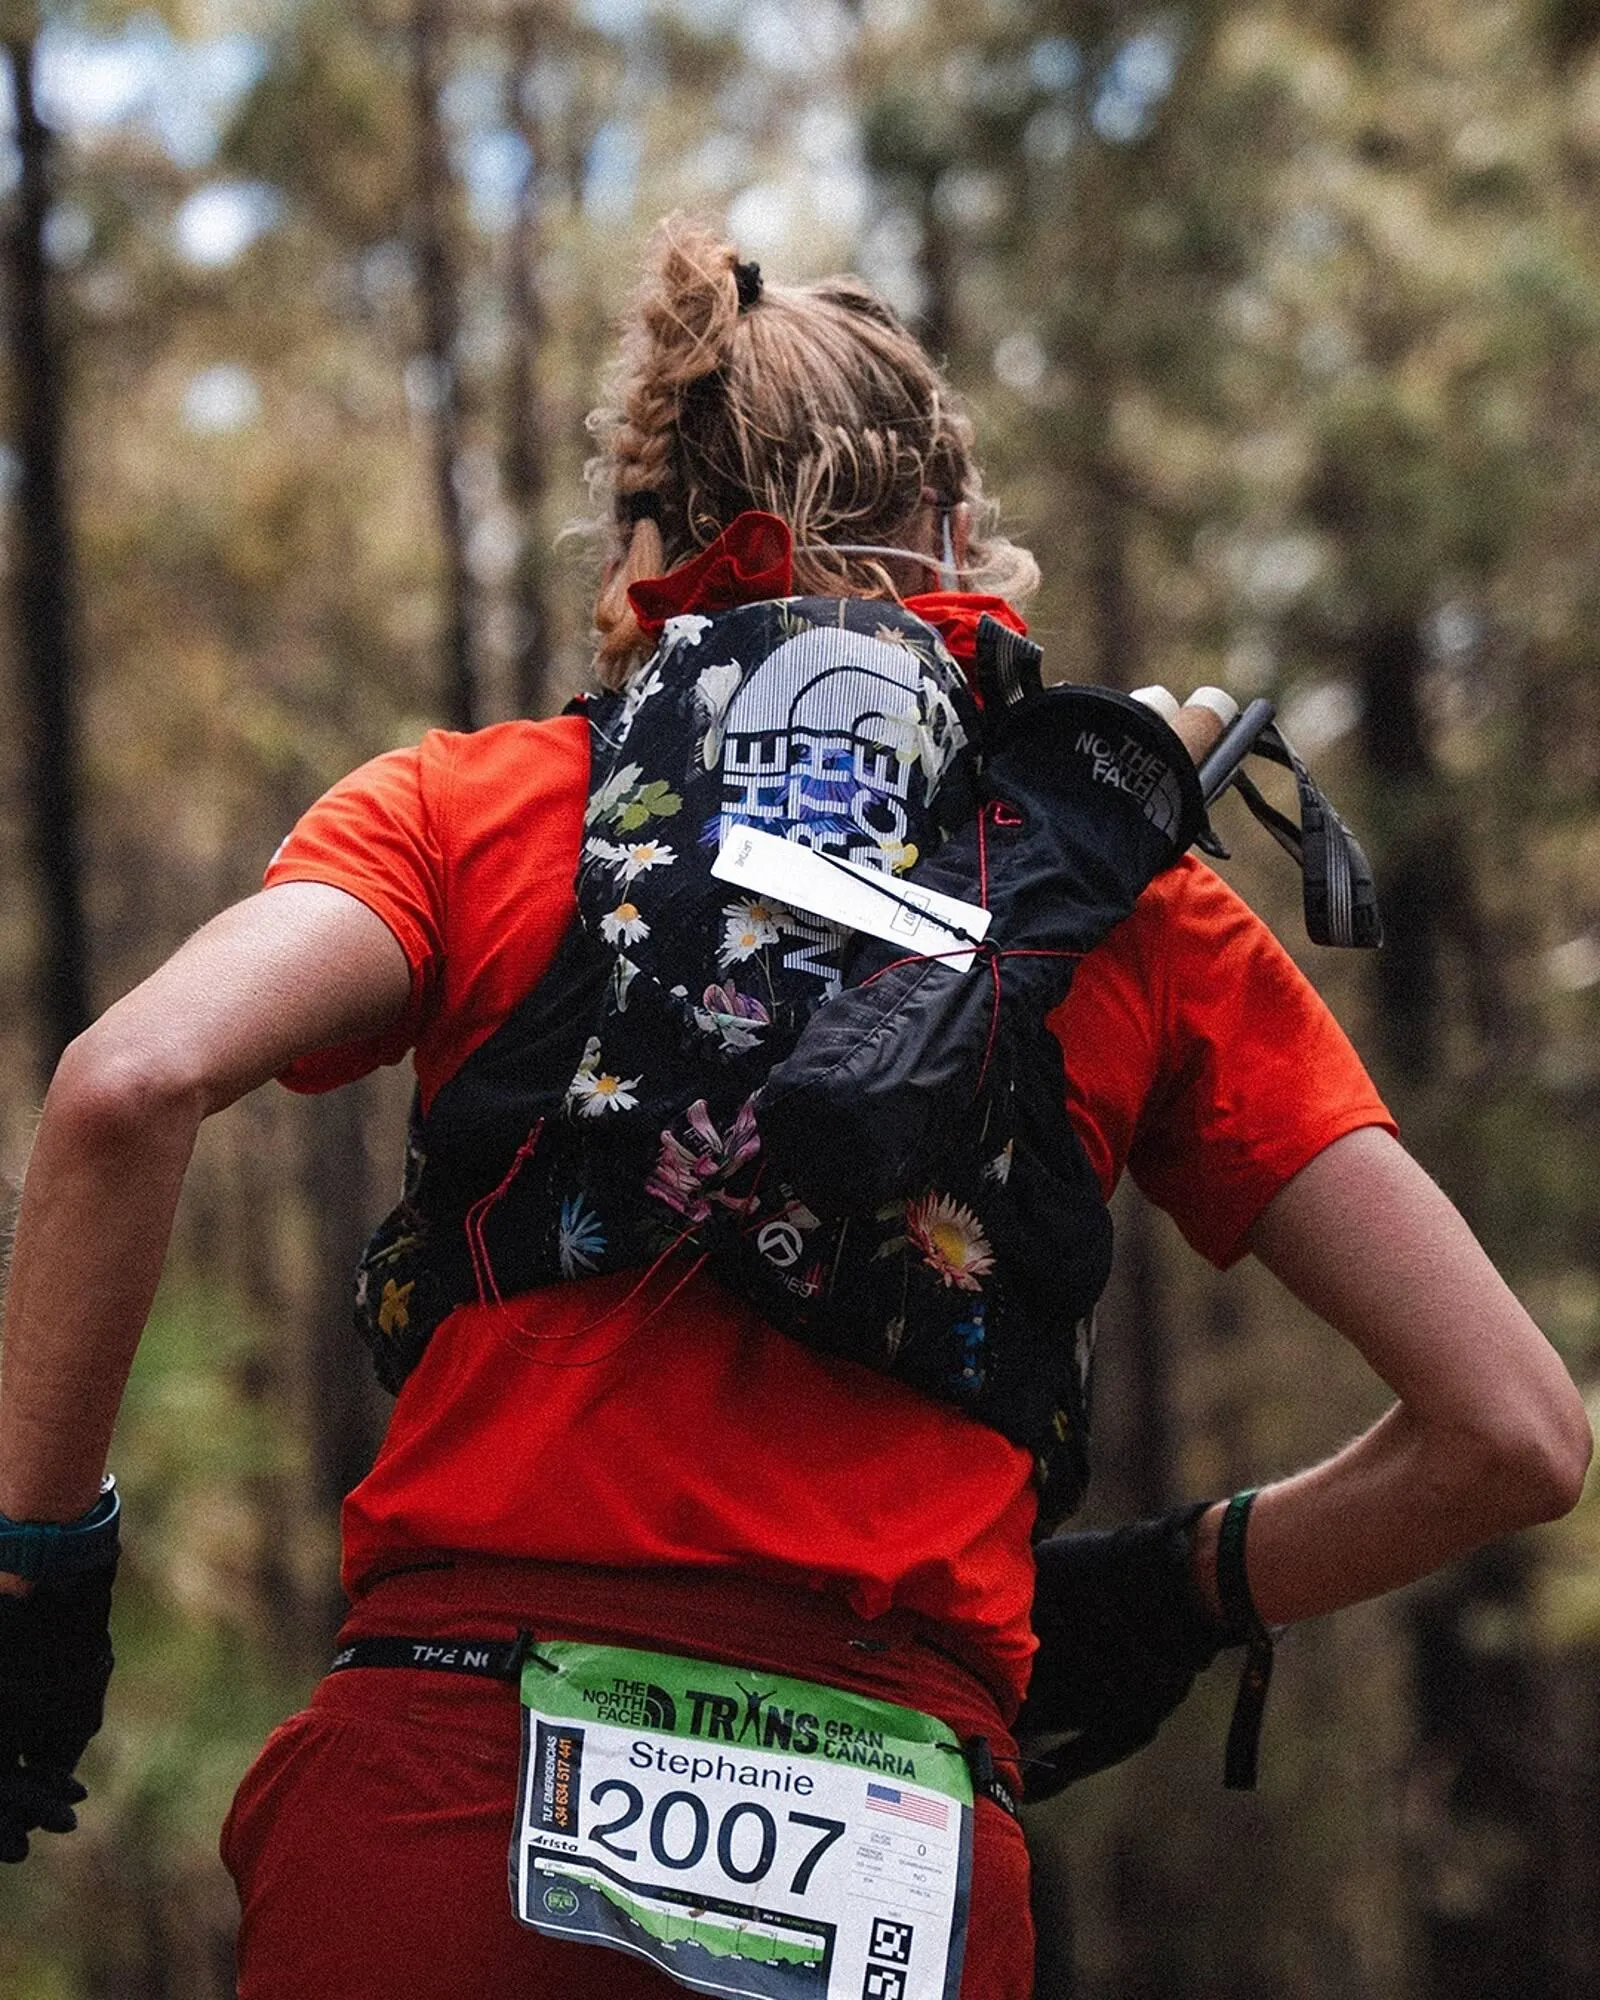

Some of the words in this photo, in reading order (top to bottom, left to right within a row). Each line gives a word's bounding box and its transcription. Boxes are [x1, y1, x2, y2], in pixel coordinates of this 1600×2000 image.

[783, 733, 851, 980] NRTH
[583, 1688, 643, 1710] NORTH
[612, 1678, 646, 1696] THE
[597, 1706, 642, 1726] FACE
[825, 1719, 884, 1750] GRAN
[544, 1735, 557, 1803] EMERGENCIAS
[557, 1759, 571, 1781] 517
[628, 1740, 815, 1796] Stephanie
[823, 1739, 917, 1780] CANARIA
[555, 1806, 568, 1828] +34
[588, 1779, 847, 1896] 2007
